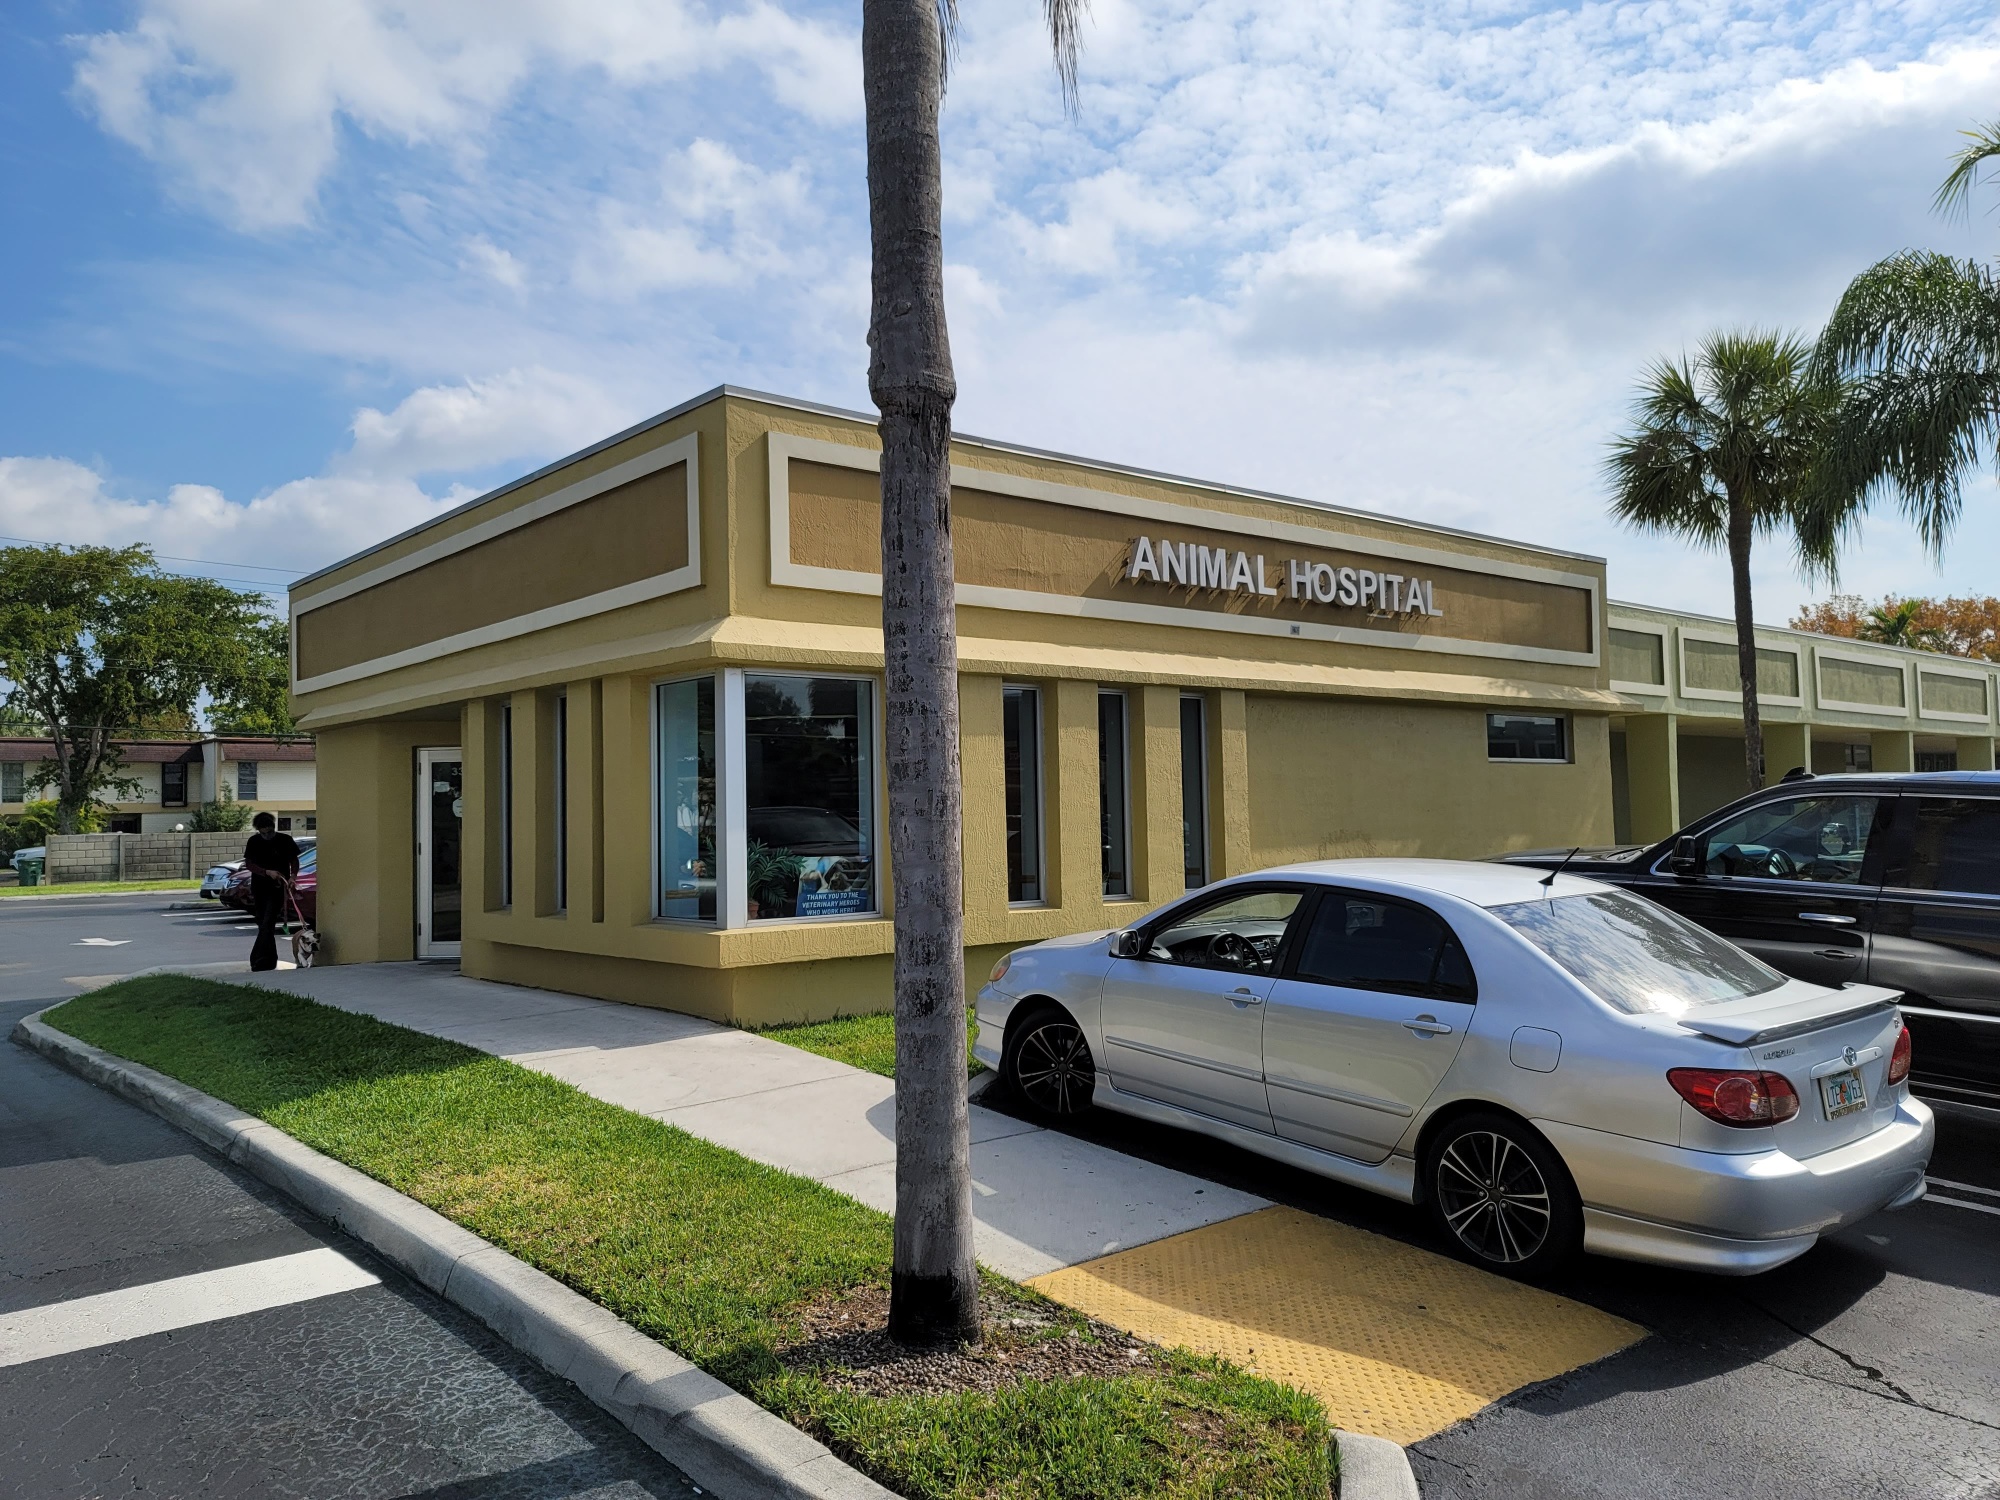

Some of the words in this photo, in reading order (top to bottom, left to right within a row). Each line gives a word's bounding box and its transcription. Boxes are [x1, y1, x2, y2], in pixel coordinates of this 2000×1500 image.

[1129, 536, 1277, 597] ANIMAL
[1288, 558, 1443, 617] HOSPITAL
[802, 900, 838, 908] VETERINARY
